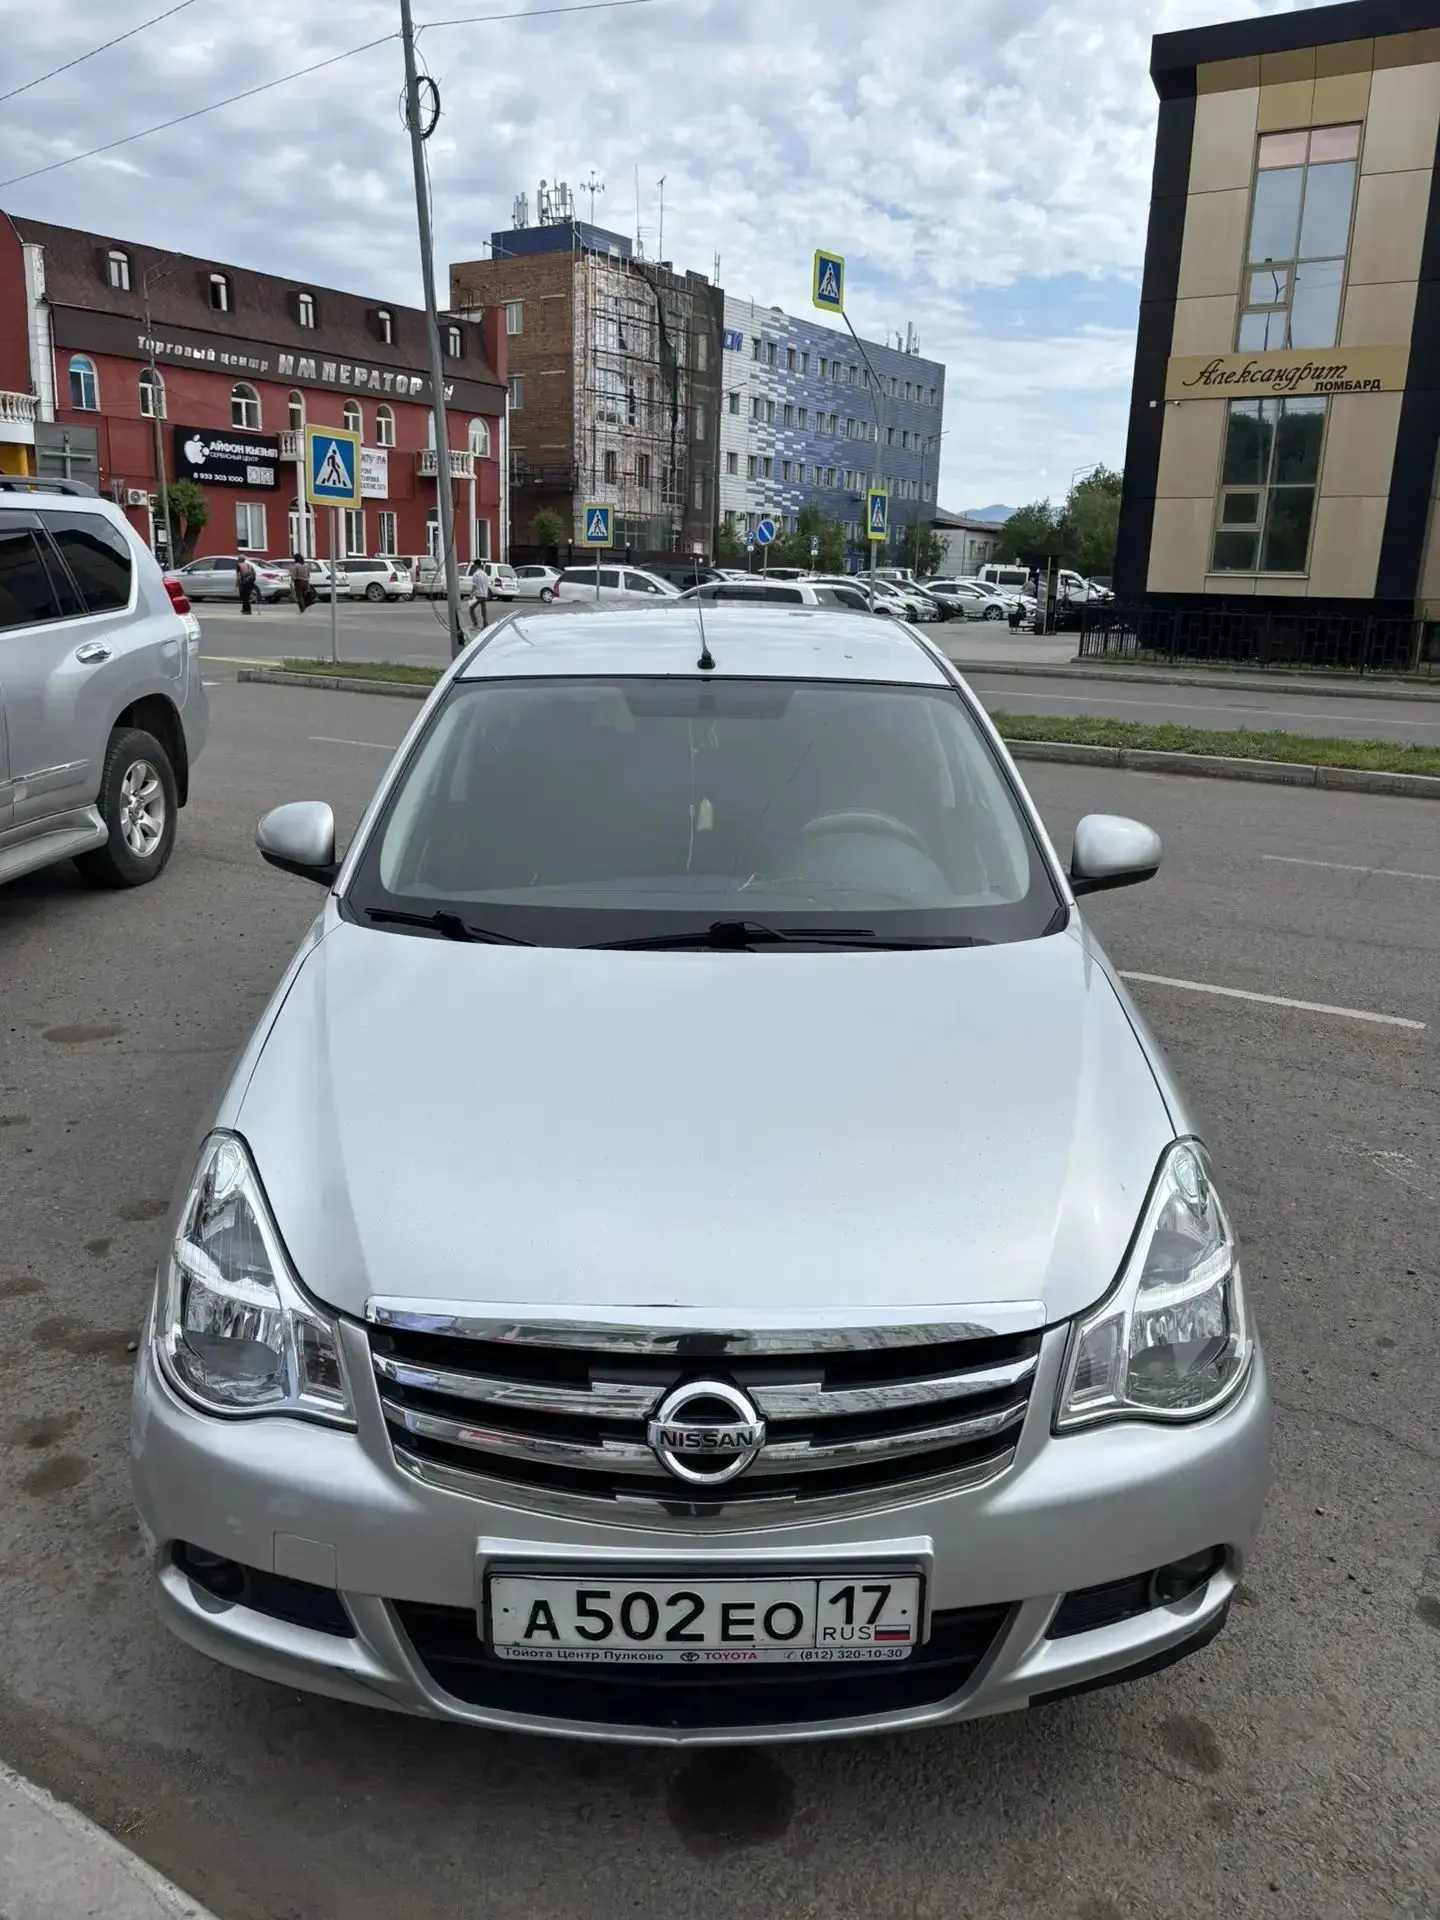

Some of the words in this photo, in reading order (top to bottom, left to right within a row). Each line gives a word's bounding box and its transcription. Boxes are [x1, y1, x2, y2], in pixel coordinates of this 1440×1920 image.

[278, 353, 424, 396] ИМПЕРАТОР
[1182, 358, 1348, 391] Александрит
[1314, 379, 1381, 392] ЛОМБАРД
[209, 440, 244, 454] АЙФОН
[245, 445, 278, 458] КЫЗЫЛ
[660, 1431, 752, 1448] NISSAN
[828, 1584, 891, 1625] 17
[823, 1625, 871, 1641] RUS
[504, 1646, 553, 1658] Тойота
[557, 1650, 600, 1661] Центр
[604, 1650, 664, 1662] Пулково
[704, 1651, 758, 1661] TOYOTA
[800, 1649, 834, 1661] (812)
[837, 1648, 903, 1660] 320-10-30
